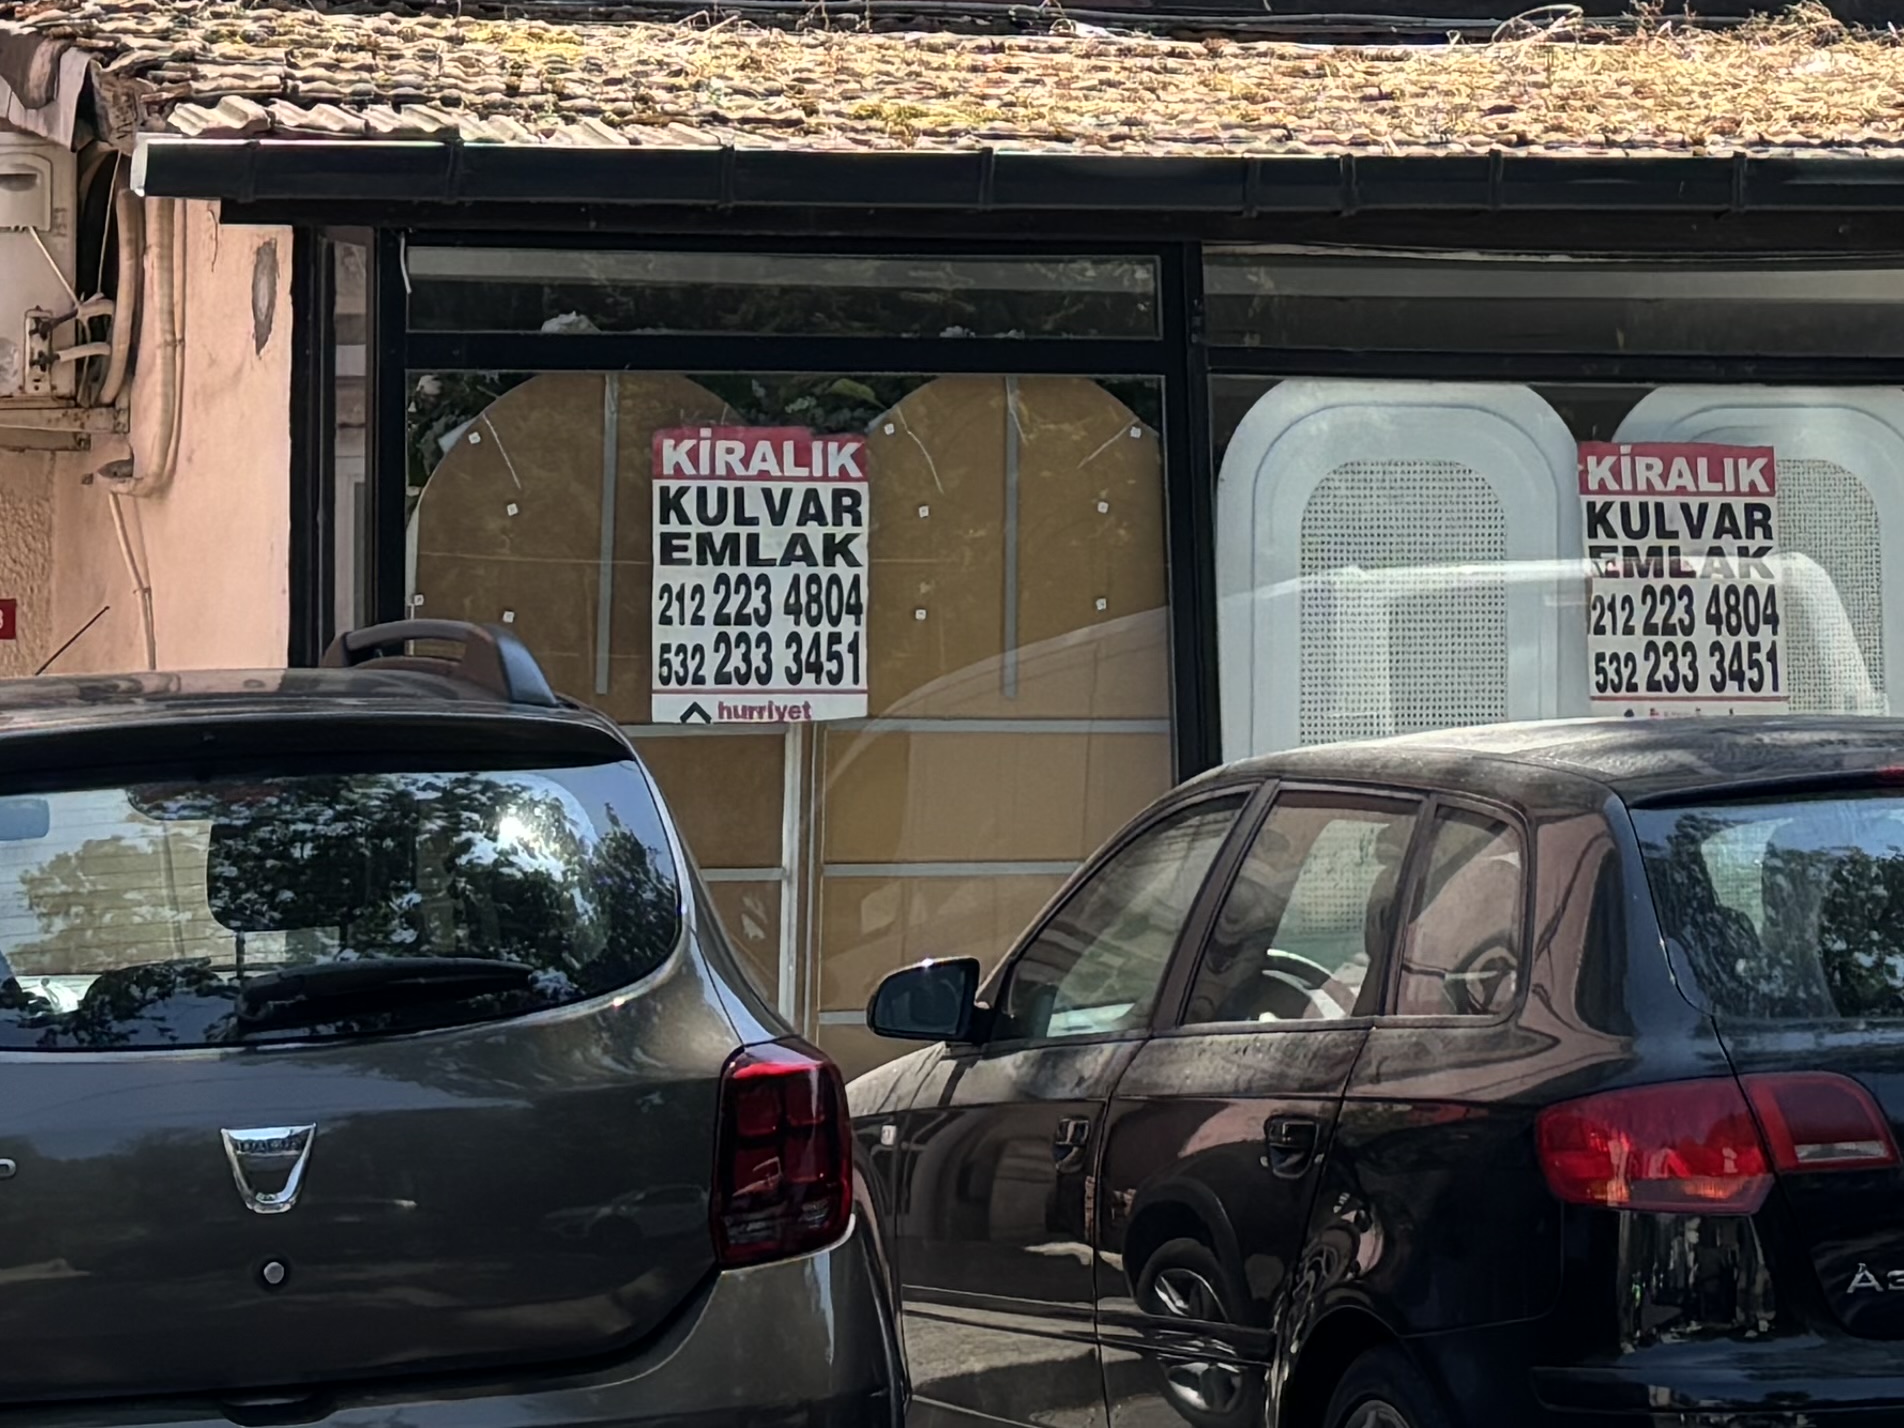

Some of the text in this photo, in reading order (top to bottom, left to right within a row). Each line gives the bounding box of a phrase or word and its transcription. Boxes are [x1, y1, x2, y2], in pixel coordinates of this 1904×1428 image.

[662, 428, 864, 477] KİRALIK
[1587, 445, 1770, 492] KİRALIK
[659, 486, 863, 527] KULVAR
[1586, 501, 1773, 540] KULVAR
[659, 532, 863, 567] EMLAK
[1588, 545, 1775, 578] EMLAK
[659, 573, 863, 627] 212 223 4804
[1592, 584, 1779, 637] 212 223 4804
[658, 631, 860, 686] 532 233 3451
[1595, 640, 1779, 694] 532 233 3451
